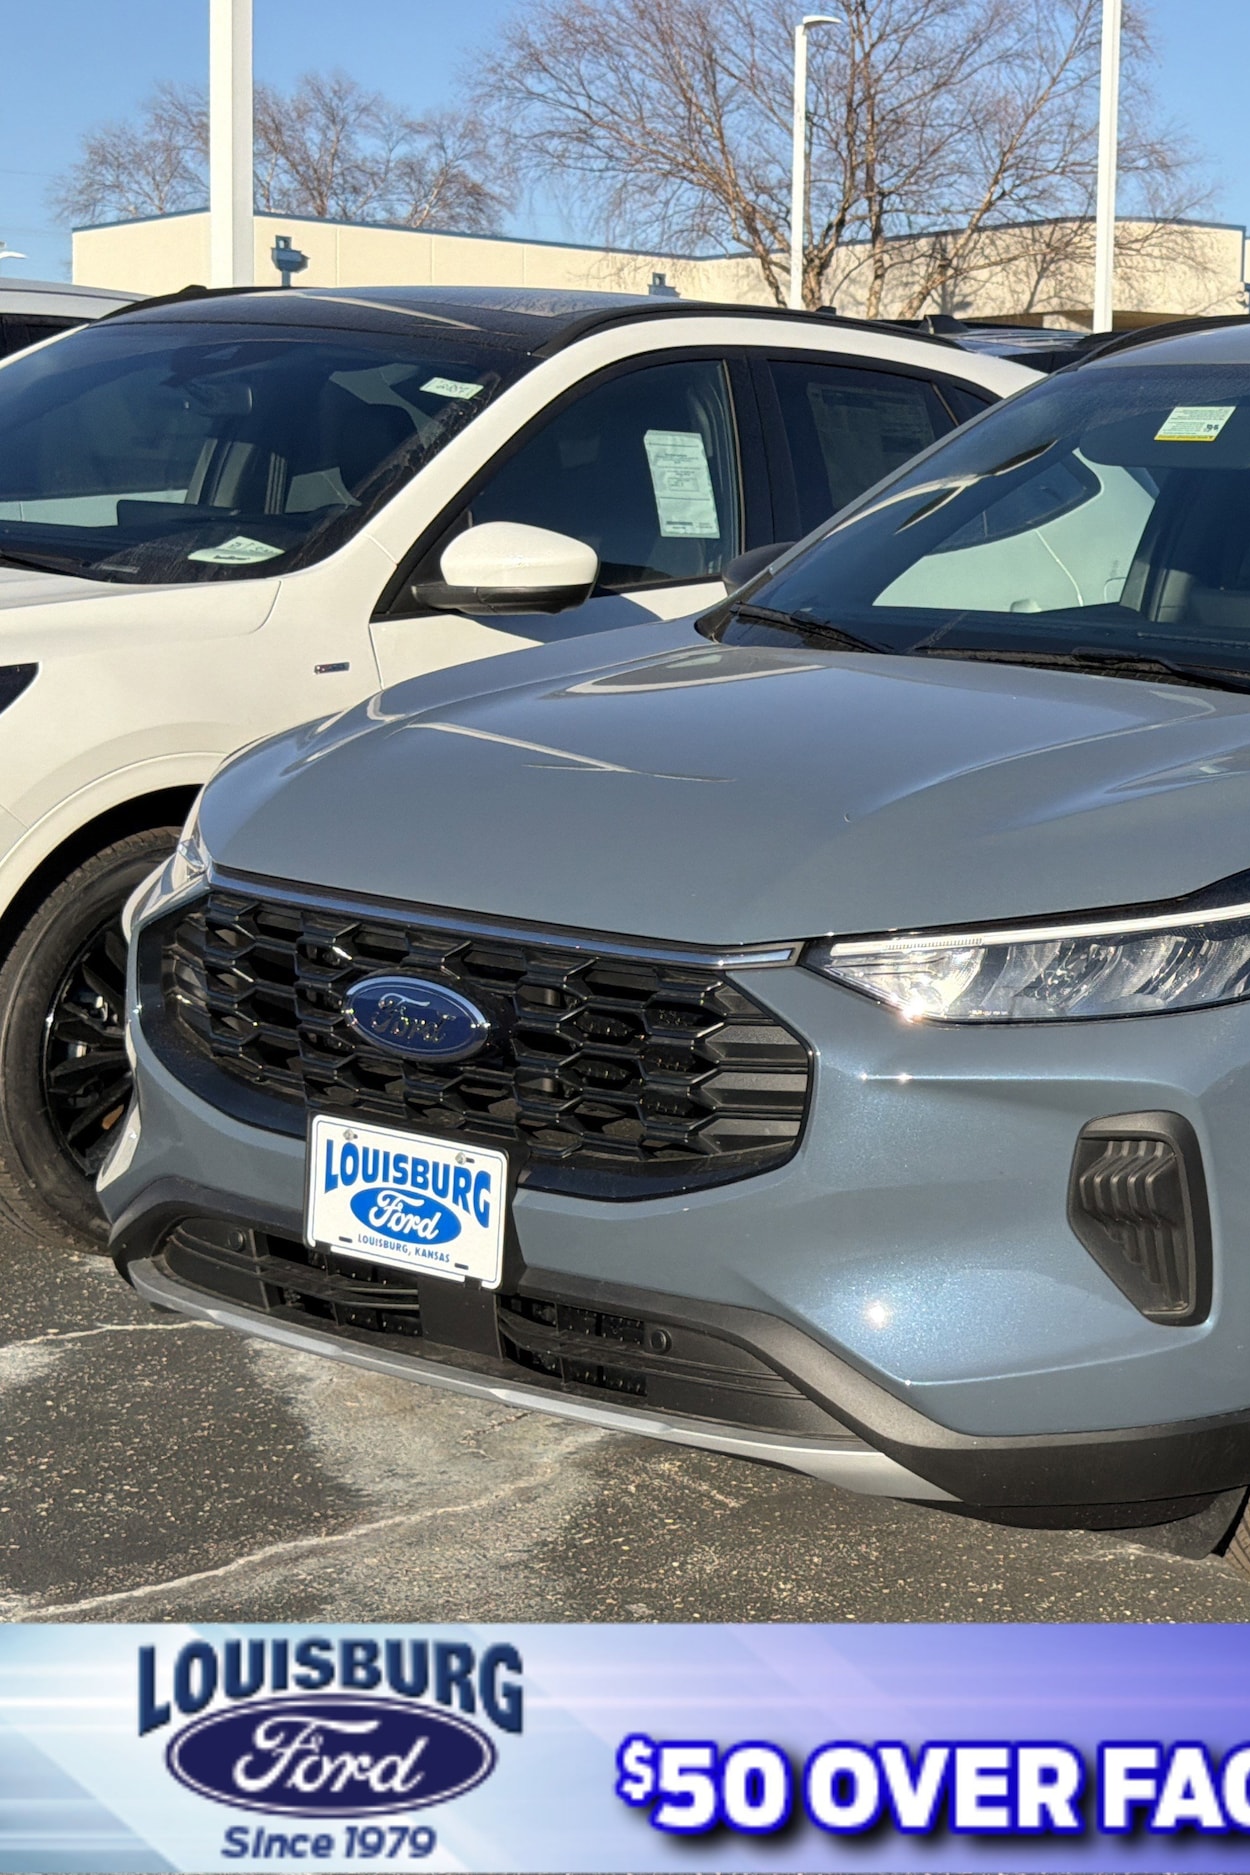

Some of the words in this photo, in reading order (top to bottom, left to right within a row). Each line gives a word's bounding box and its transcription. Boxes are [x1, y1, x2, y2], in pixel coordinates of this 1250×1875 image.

[372, 992, 455, 1045] Ford
[324, 1138, 492, 1230] LOUISBURG
[368, 1190, 443, 1241] Ford
[357, 1233, 412, 1257] LOUISBURG,
[414, 1247, 451, 1264] KANSAS
